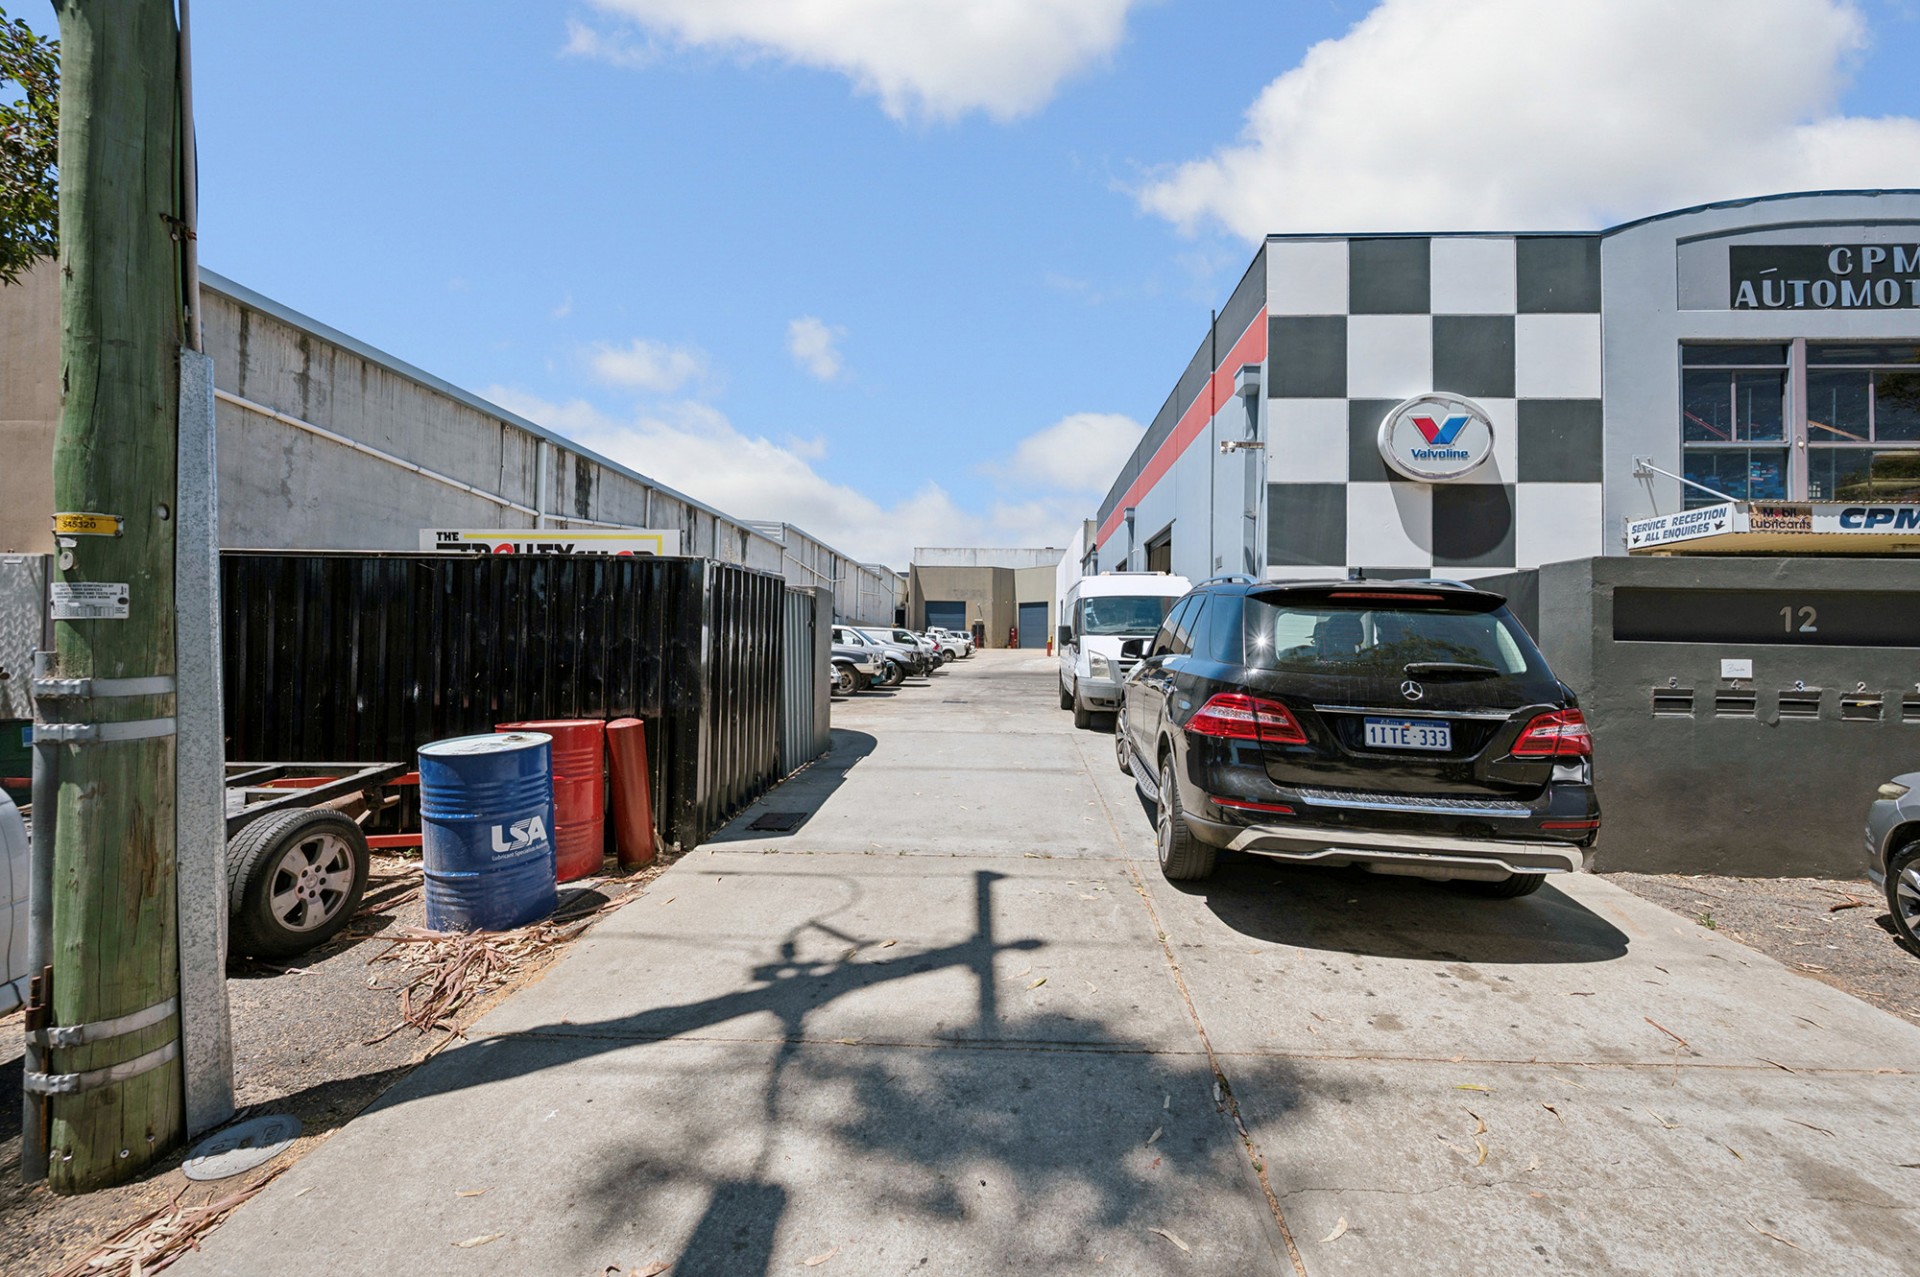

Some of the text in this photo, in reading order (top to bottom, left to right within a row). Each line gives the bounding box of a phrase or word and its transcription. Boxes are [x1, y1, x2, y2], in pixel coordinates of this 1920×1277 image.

[1828, 246, 1920, 275] CPM
[1411, 448, 1470, 459] Valvoline
[1631, 507, 1727, 535] SERVICE RECEPTION
[1750, 518, 1812, 530] Lubricants
[1839, 507, 1920, 529] CPM
[436, 531, 459, 541] THE
[1644, 522, 1710, 543] ALL ENQUIRES
[1779, 605, 1818, 633] 12
[1668, 676, 1679, 689] 5
[1730, 678, 1740, 690] 4
[1795, 680, 1805, 692] 3
[1857, 681, 1867, 693] 2
[491, 815, 548, 853] LSA
